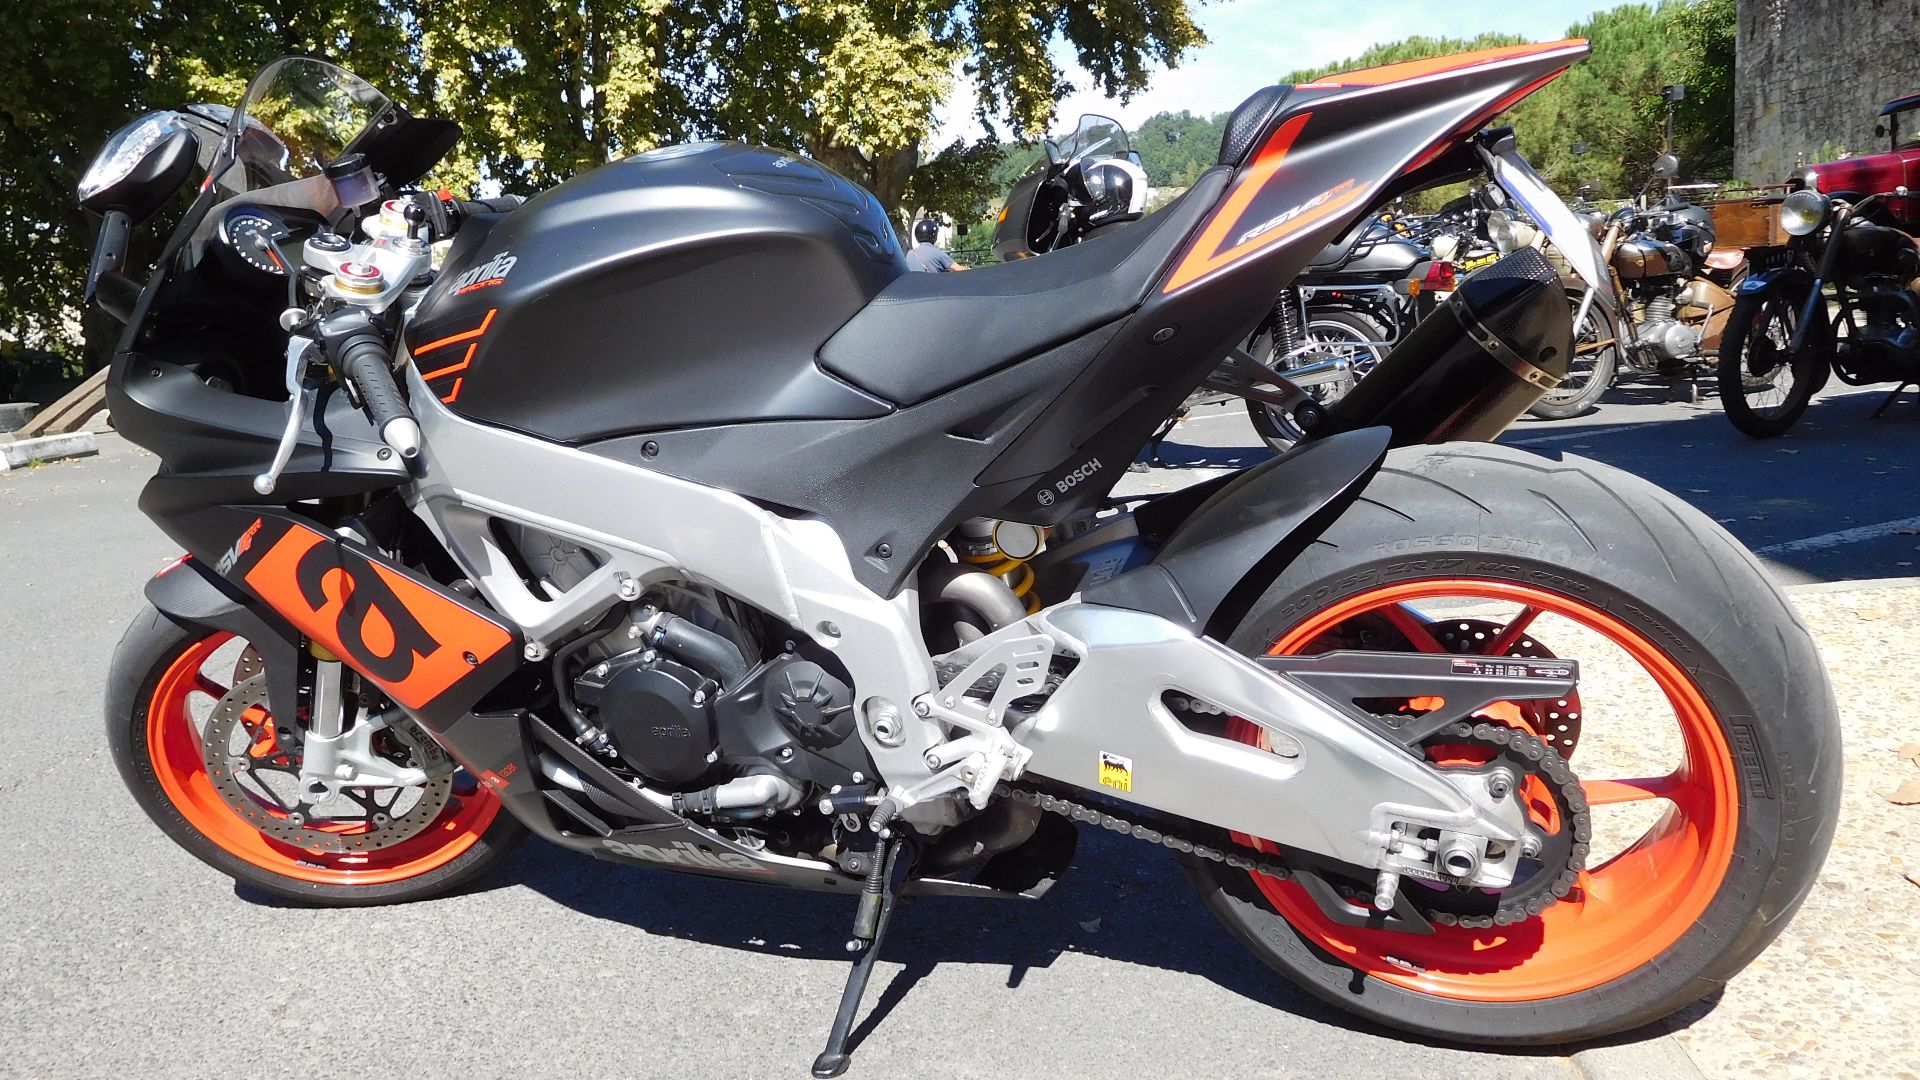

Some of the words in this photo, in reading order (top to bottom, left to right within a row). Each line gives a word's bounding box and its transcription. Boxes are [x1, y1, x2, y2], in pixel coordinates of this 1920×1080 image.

[448, 251, 518, 295] aprilia
[1055, 457, 1103, 494] BOSCH
[1374, 534, 1478, 552] ROSSO
[409, 725, 440, 761] brembo
[1728, 714, 1776, 801] PIRELLI
[1102, 776, 1128, 792] eni
[602, 839, 769, 871] aprilia
